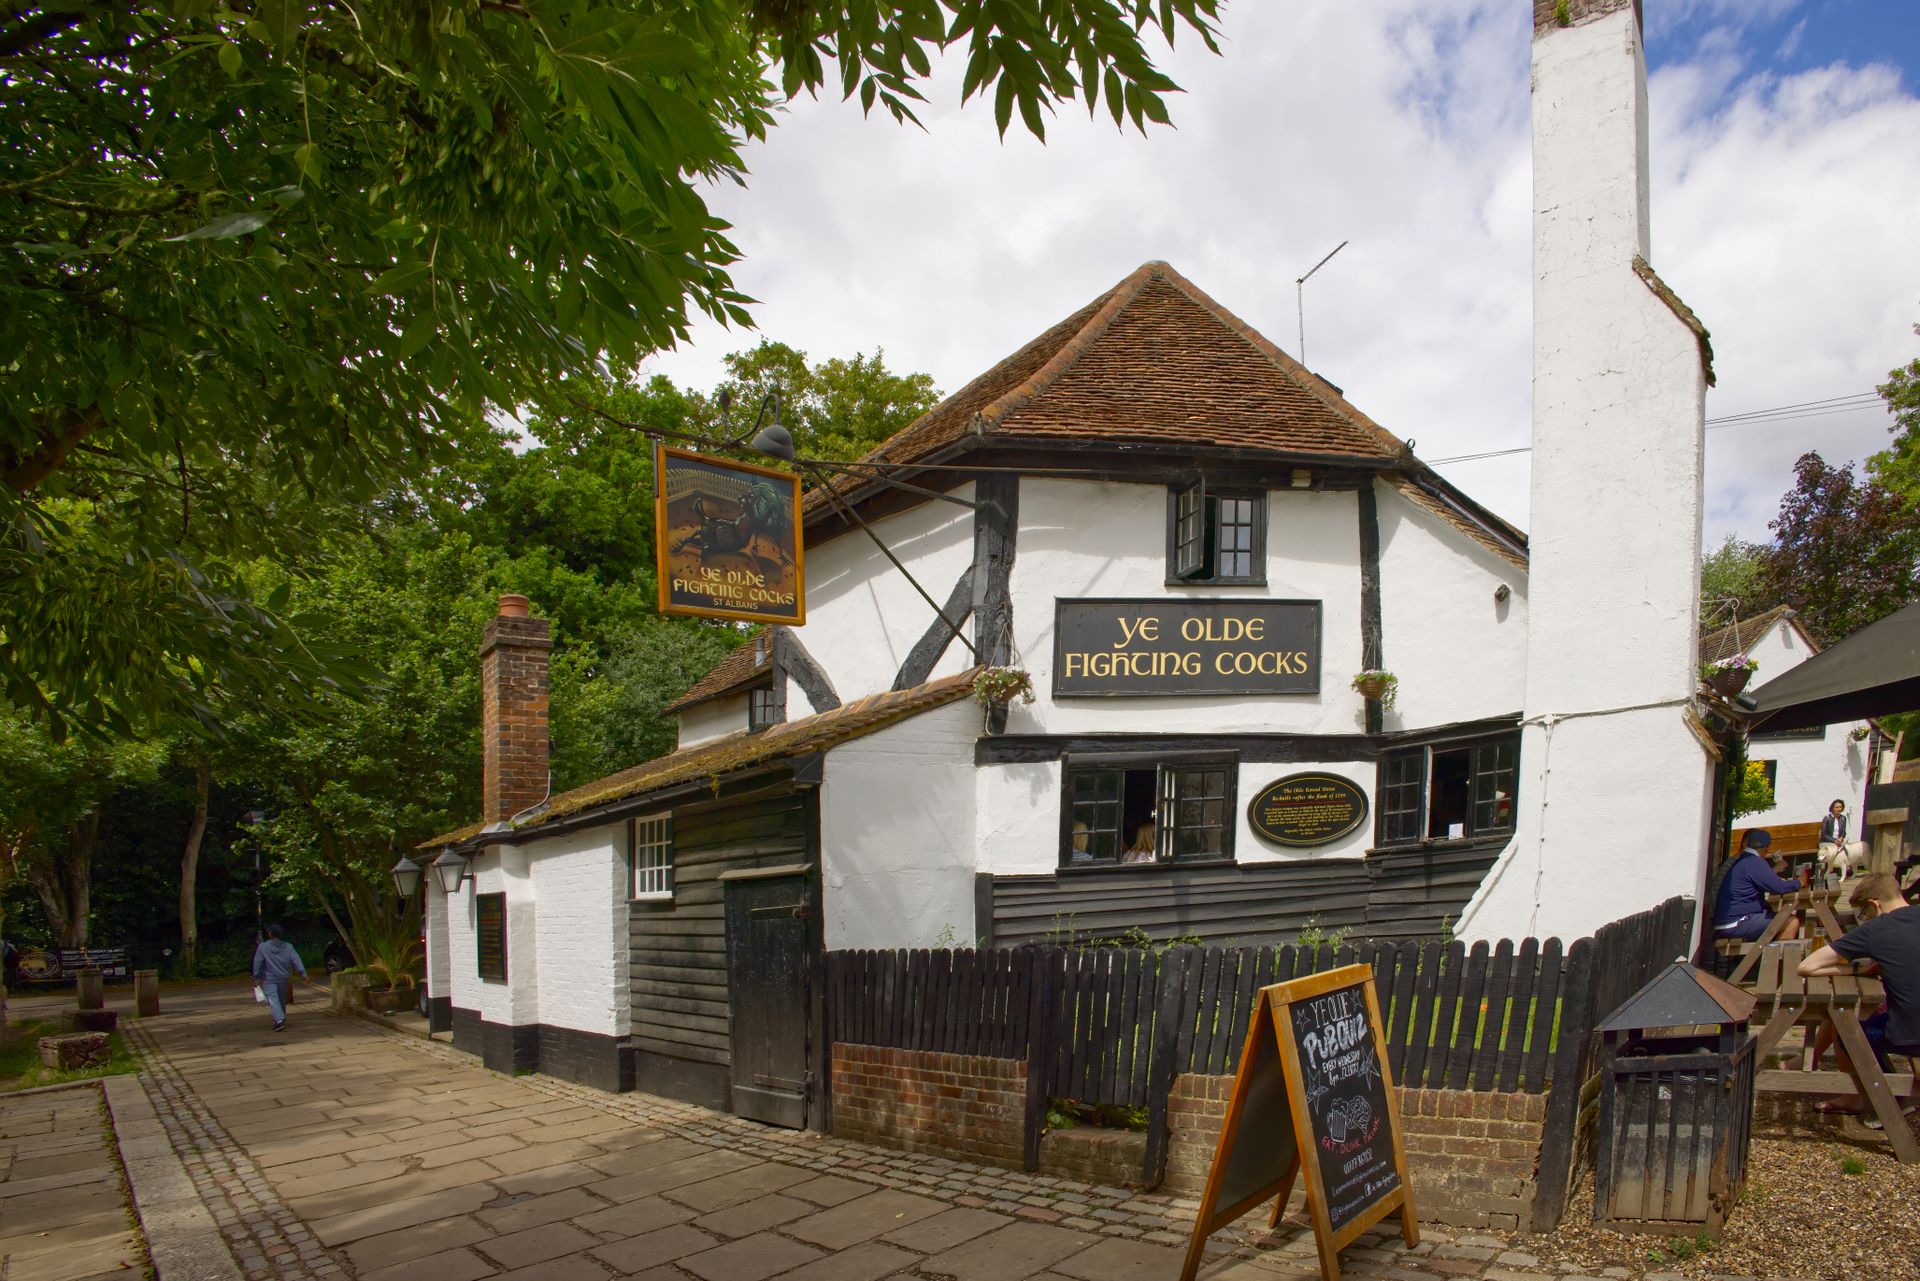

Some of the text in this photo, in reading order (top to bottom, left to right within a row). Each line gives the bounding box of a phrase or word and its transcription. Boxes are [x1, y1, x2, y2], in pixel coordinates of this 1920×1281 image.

[727, 570, 765, 587] OLDE
[673, 578, 795, 605] FIGHTING COCKS
[713, 599, 758, 610] ST ALBANS
[1181, 617, 1265, 641] OLDE
[1065, 651, 1308, 677] FIGHTING COCKS
